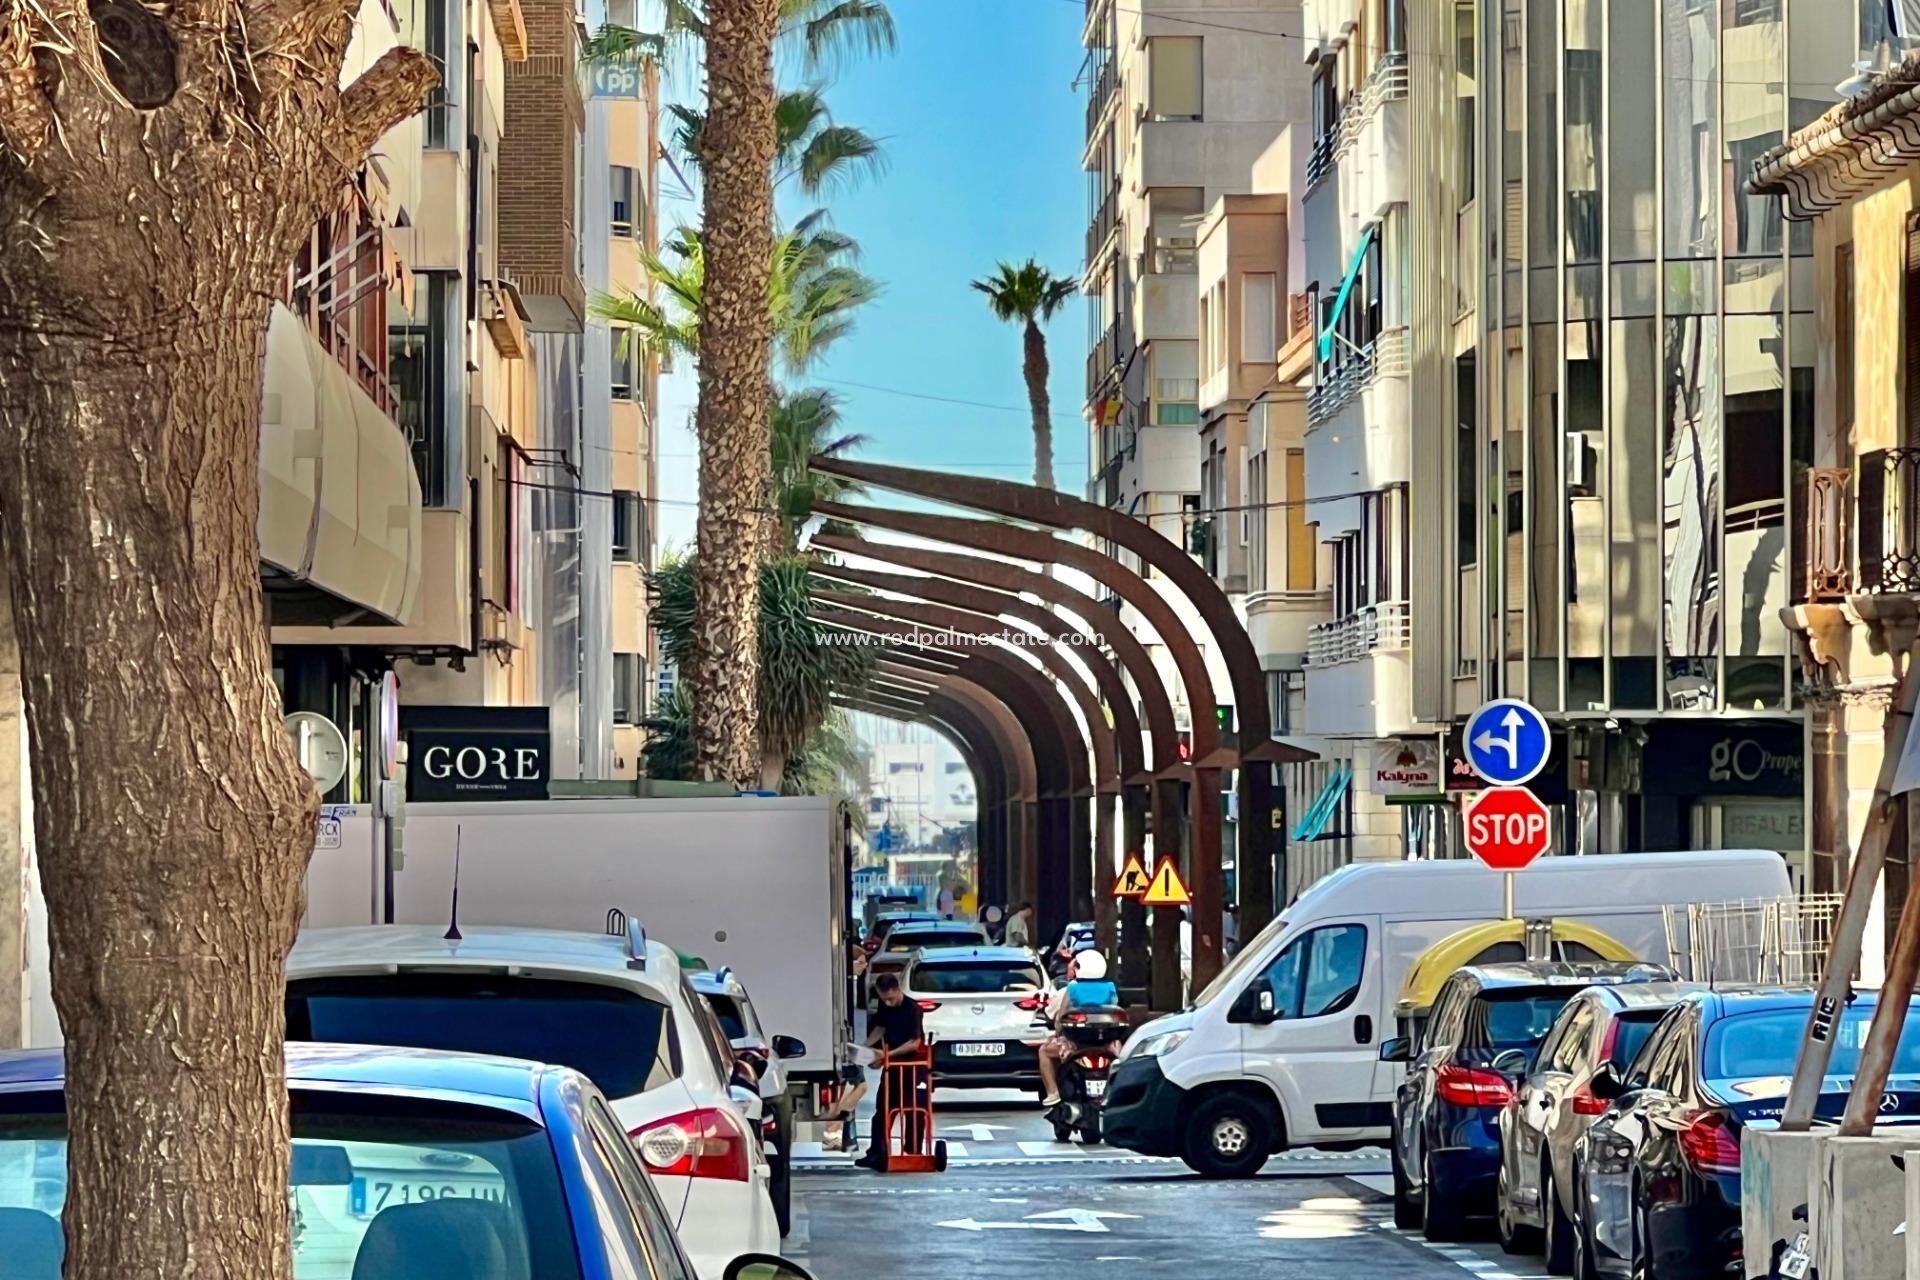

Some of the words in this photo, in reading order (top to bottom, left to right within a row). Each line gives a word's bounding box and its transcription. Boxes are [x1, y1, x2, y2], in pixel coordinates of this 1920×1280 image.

[424, 745, 540, 780] GORE
[1376, 770, 1428, 784] Kalyna
[1471, 813, 1545, 846] STOP
